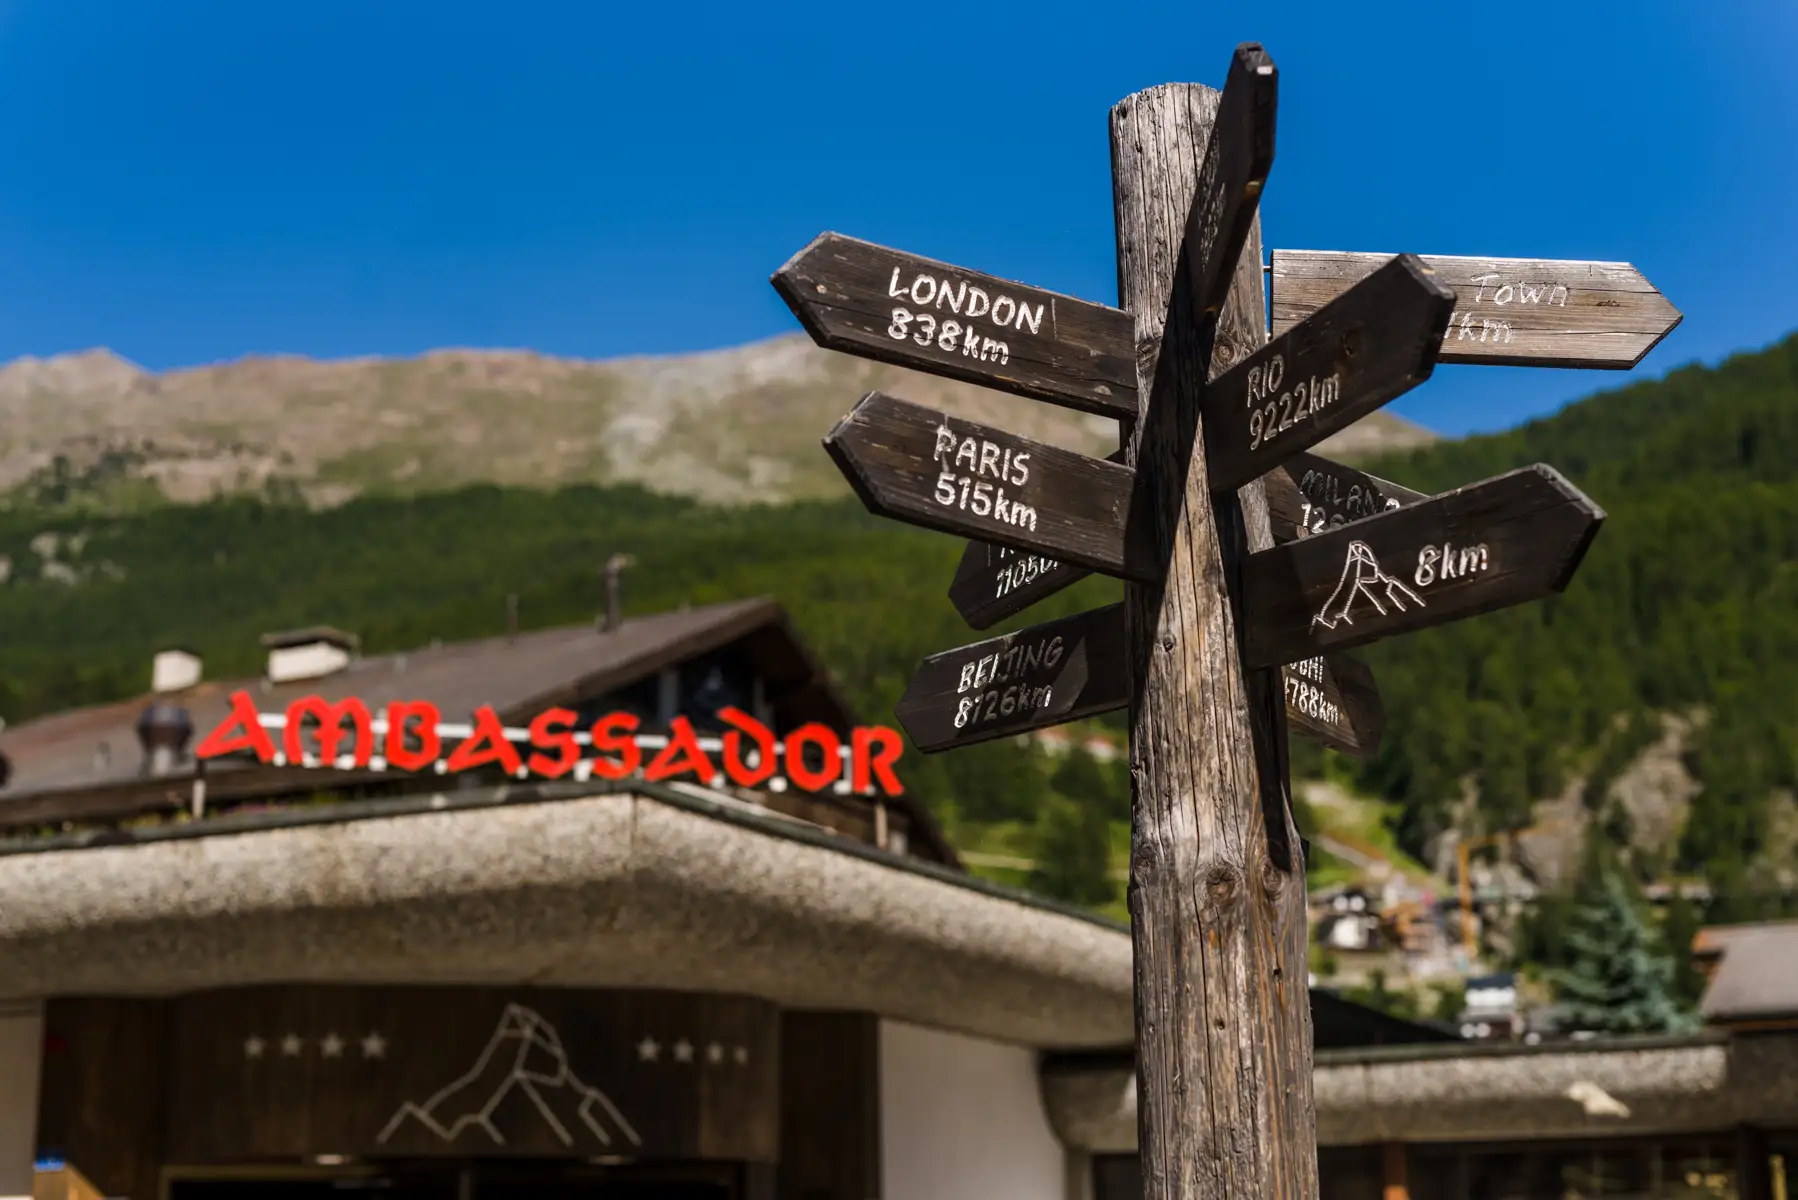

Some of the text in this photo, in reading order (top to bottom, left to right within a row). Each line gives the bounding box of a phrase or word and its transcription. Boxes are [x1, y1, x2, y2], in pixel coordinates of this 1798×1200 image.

[889, 266, 1044, 334] LONDON
[1470, 273, 1571, 307] Town
[888, 307, 1009, 365] 838km
[1247, 354, 1284, 408] RIO
[1250, 373, 1340, 450] 9222km
[934, 424, 1031, 486] PARIS
[935, 472, 1037, 532] 515km
[1415, 542, 1488, 586] 8km
[957, 636, 1064, 694] BEIJING
[954, 682, 1054, 729] 8126km
[195, 690, 906, 796] AMBASSADOR
